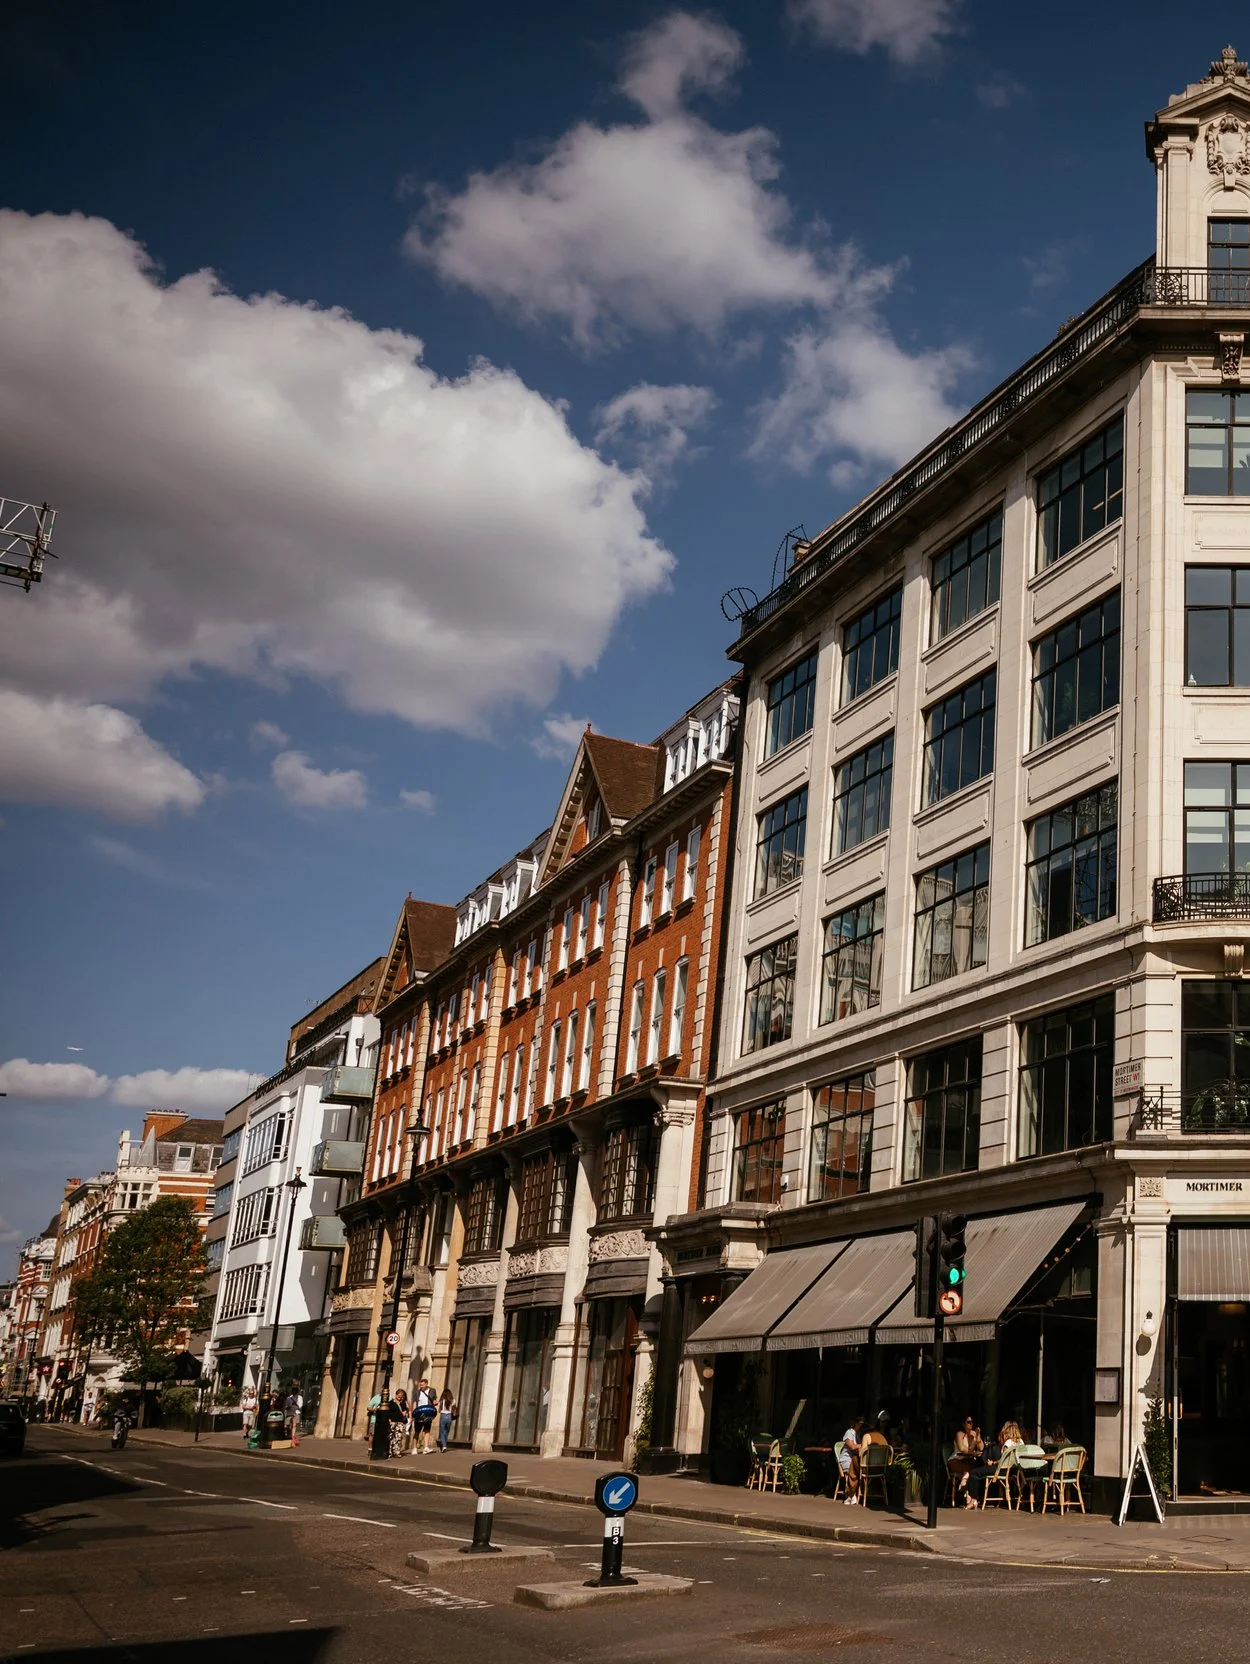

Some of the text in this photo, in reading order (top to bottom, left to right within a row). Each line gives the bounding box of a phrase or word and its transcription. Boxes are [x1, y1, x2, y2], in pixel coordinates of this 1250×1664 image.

[1115, 1063, 1141, 1076] MORTIMER
[1115, 1072, 1140, 1086] STREET W1
[1186, 1182, 1242, 1191] MORTIMER
[613, 1527, 620, 1536] B
[612, 1536, 619, 1545] 3
